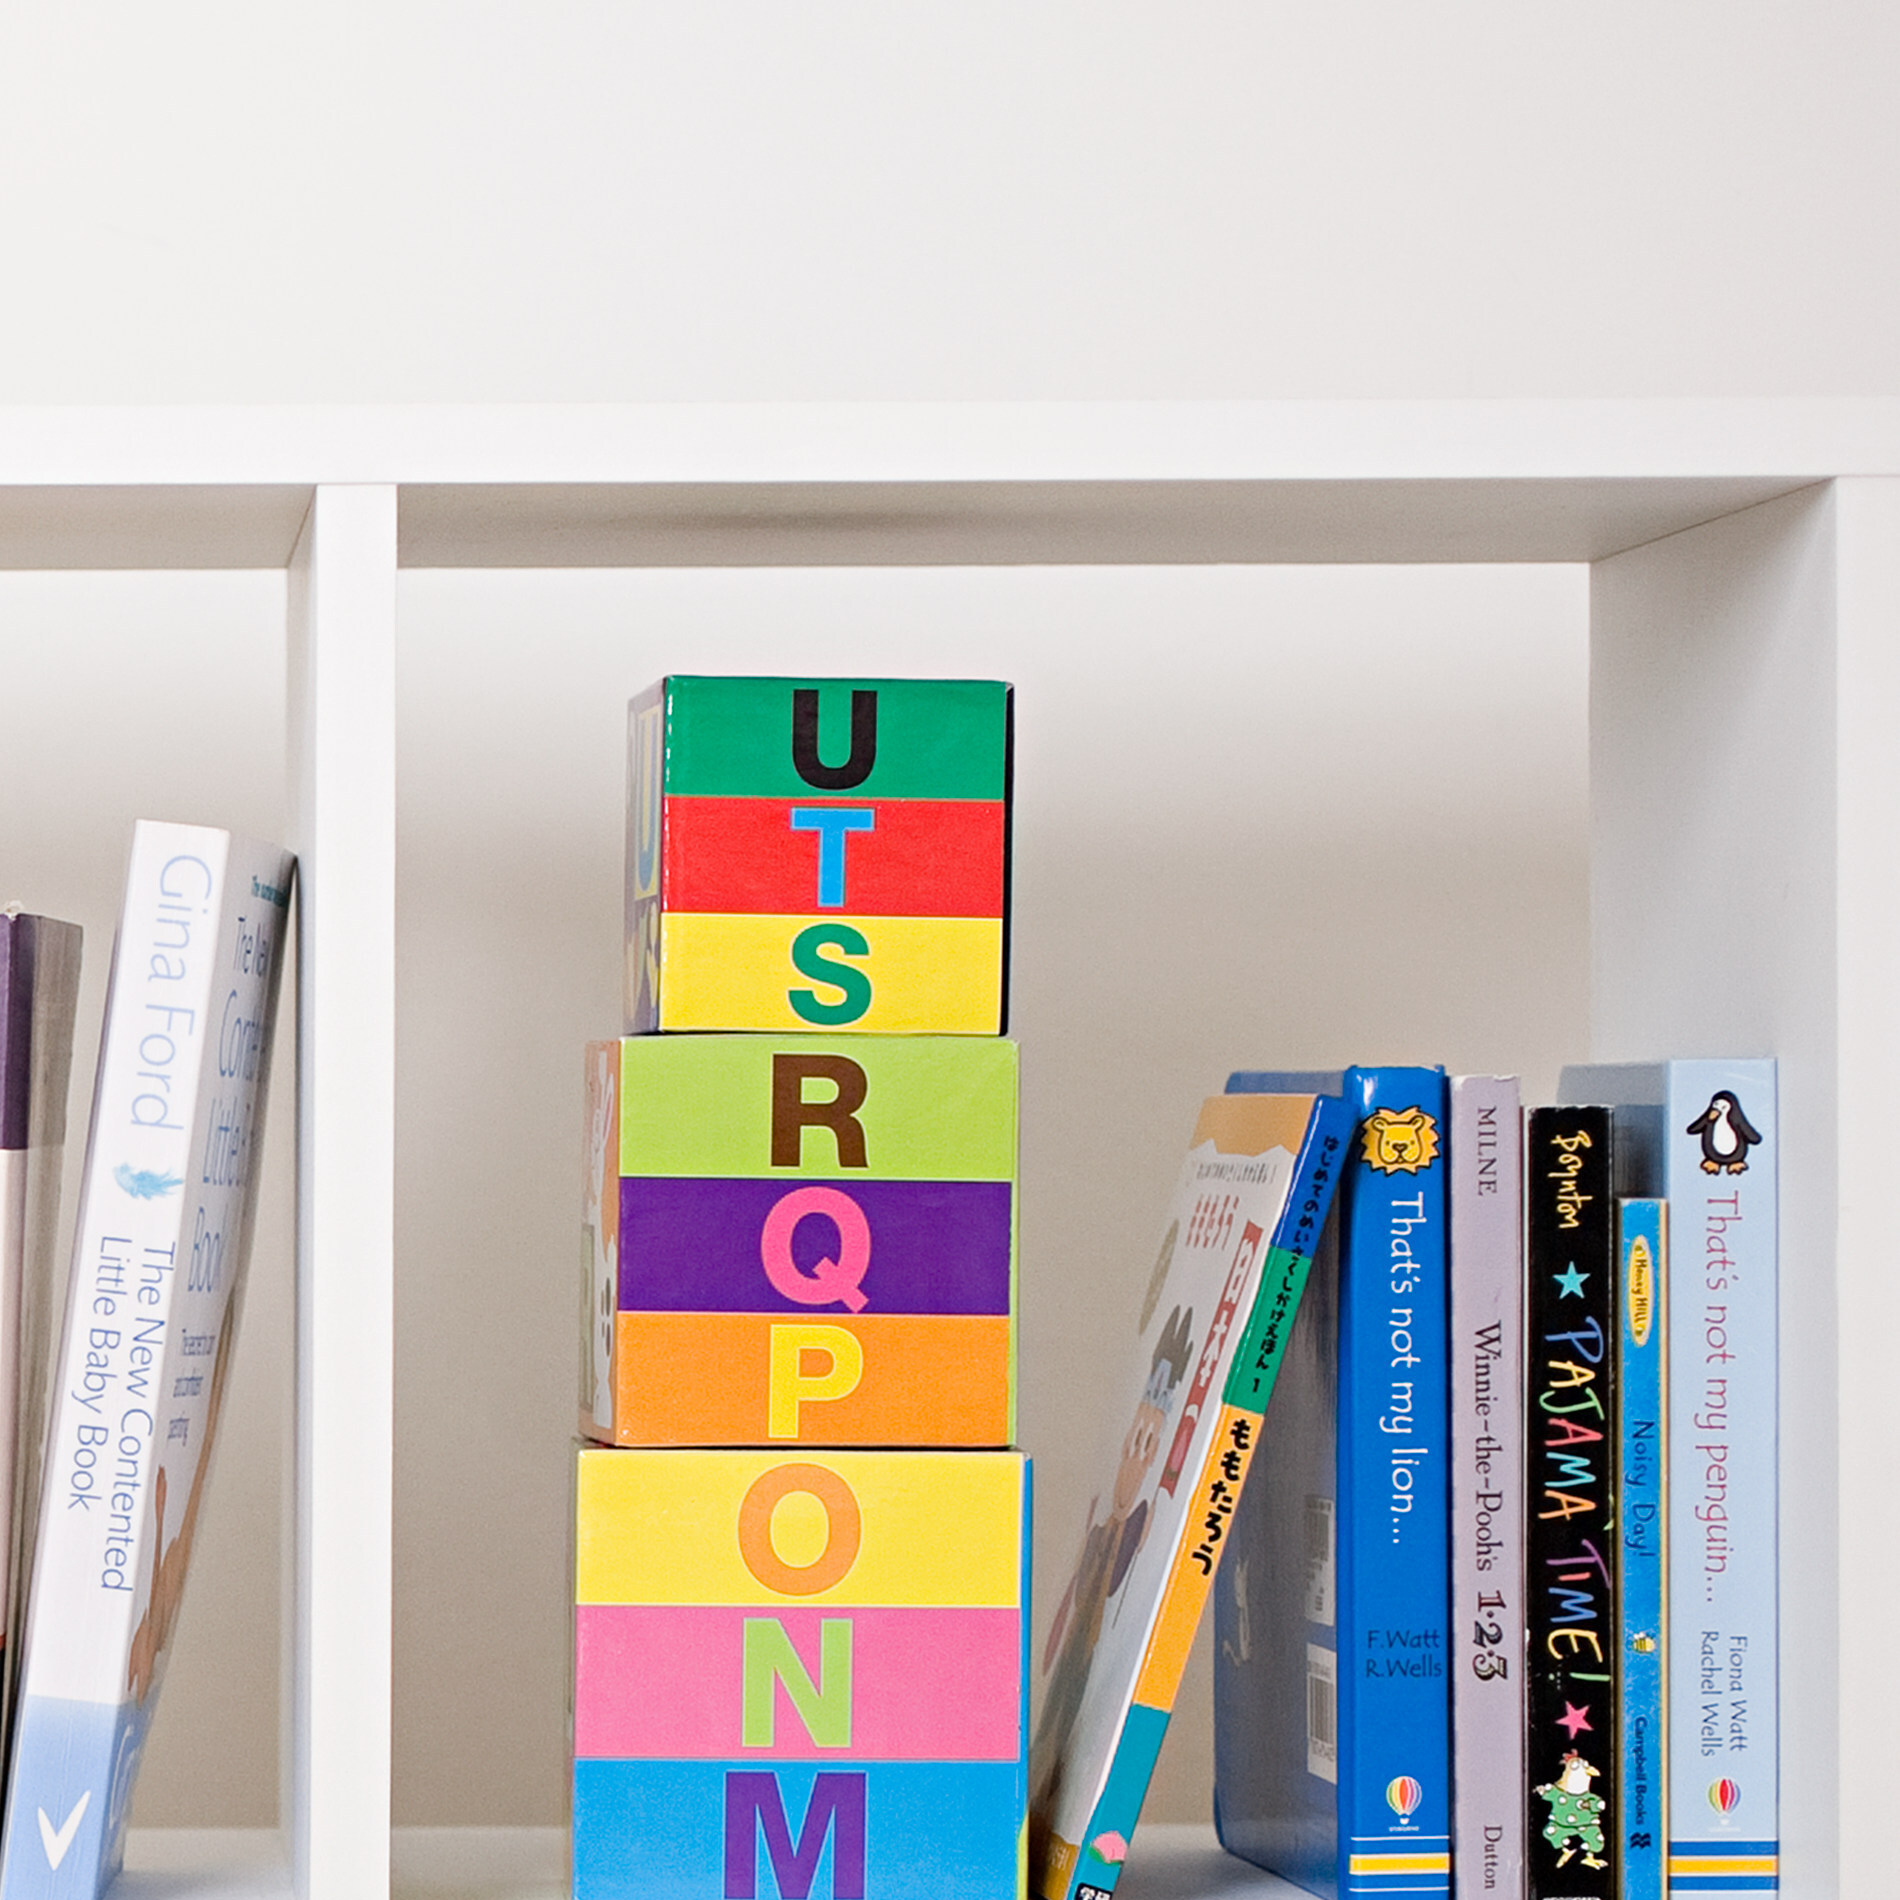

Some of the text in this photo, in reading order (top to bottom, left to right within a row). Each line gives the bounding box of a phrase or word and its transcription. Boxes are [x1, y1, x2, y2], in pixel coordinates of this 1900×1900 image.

[791, 688, 878, 790] U
[791, 807, 875, 909] T
[130, 854, 214, 1131] Gina Ford
[787, 921, 873, 1027] S
[769, 1053, 869, 1170] R
[1477, 1107, 1498, 1197] MILNE
[1548, 1129, 1593, 1230] Boynton
[759, 1185, 873, 1313] Q
[66, 1234, 133, 1513] Little Baby Book
[100, 1241, 176, 1594] The New Contented
[767, 1322, 864, 1439] P
[1379, 1191, 1429, 1545] That's not my lion...
[1693, 1190, 1743, 1602] That's not my penguin...
[1191, 1418, 1252, 1577] ももたろう
[1472, 1321, 1505, 1572] Winnie-the-Pooh's
[1625, 1420, 1656, 1557] Noisy Day!
[736, 1461, 862, 1598] O
[741, 1616, 854, 1749] N
[1699, 1630, 1724, 1758] Rachel Wells
[1728, 1635, 1749, 1752] Fiona Watt
[723, 1769, 869, 1900] M
[1483, 1825, 1503, 1891] Dutton
